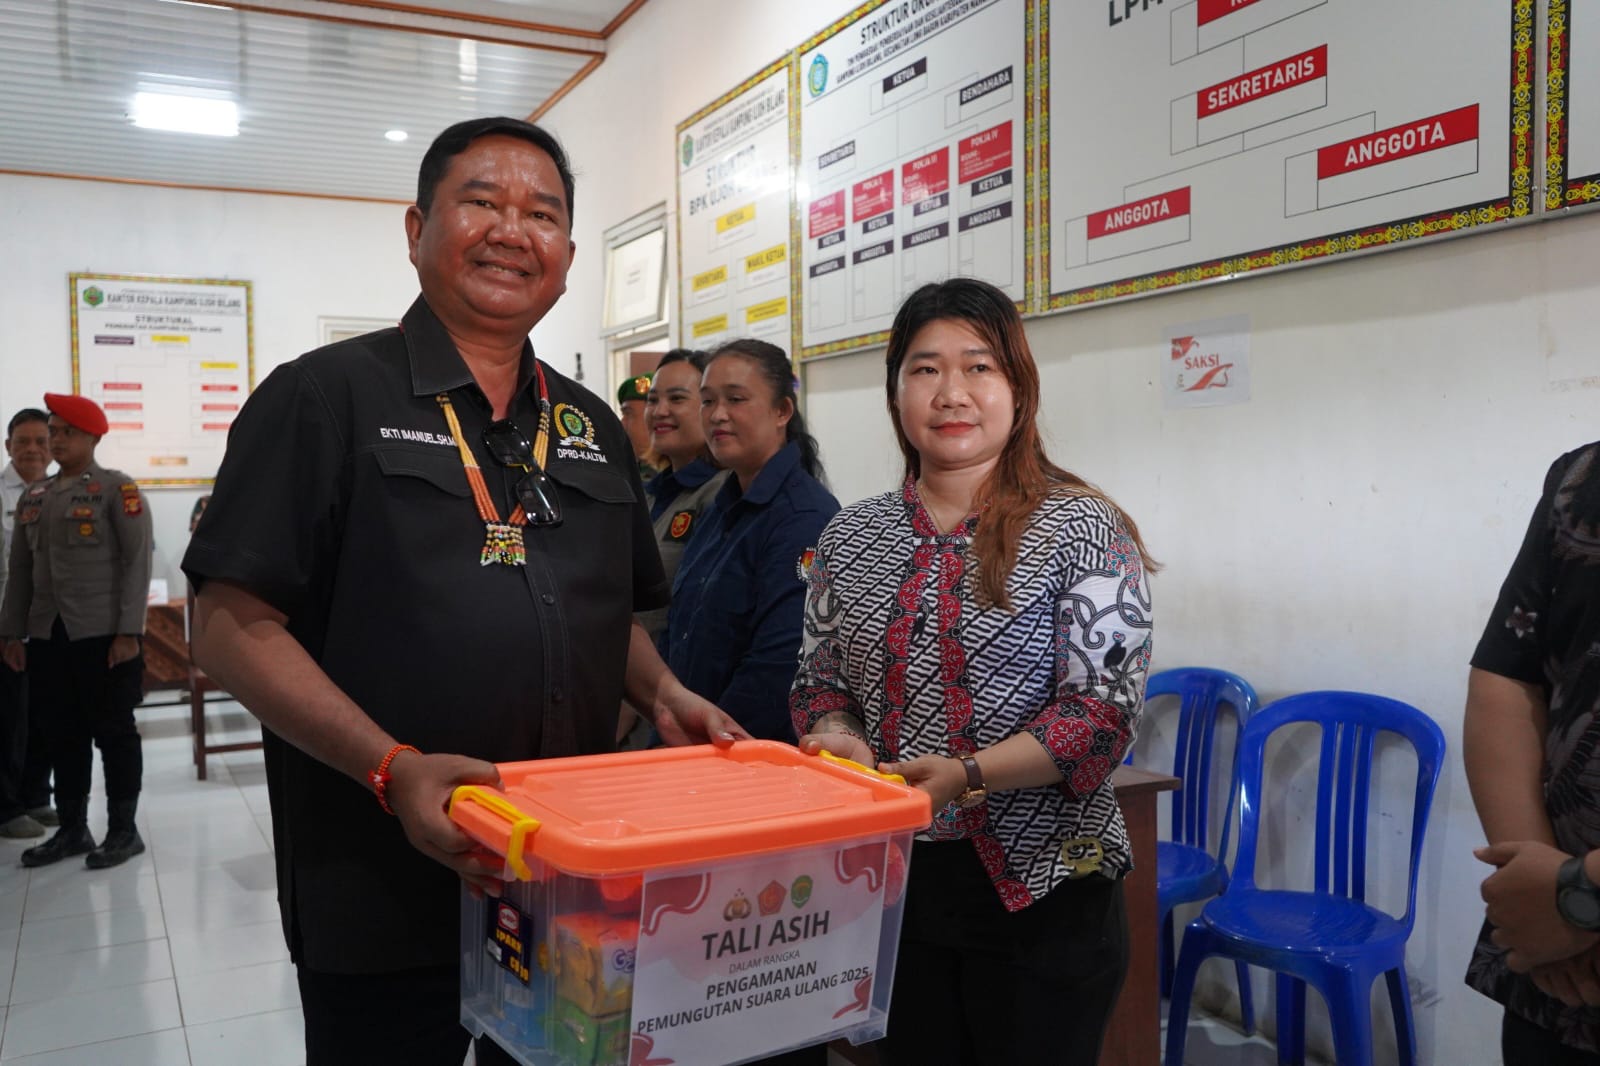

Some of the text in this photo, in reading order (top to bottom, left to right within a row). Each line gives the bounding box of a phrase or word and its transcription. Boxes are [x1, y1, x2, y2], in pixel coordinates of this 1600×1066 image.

[861, 2, 909, 45] STRUKTUR
[893, 66, 916, 86] KETUA
[961, 71, 1010, 102] BENDAHARA
[1208, 56, 1315, 110] SEKRETARIS
[1344, 121, 1446, 167] ANGGOTA
[979, 175, 1004, 192] KETUA
[968, 208, 1002, 227] ANGGOTA
[1104, 197, 1170, 231] ANGGOTA
[910, 227, 940, 244] ANGGOTA
[1185, 354, 1220, 370] SAKSI
[380, 428, 401, 439] EKTI
[557, 448, 608, 464] DPRD-KALTIM
[702, 910, 830, 960] TALI ASIH
[729, 950, 800, 975] DALAM RANGKA
[706, 961, 817, 1001] PENGAMANAN
[637, 966, 869, 1034] PEMUNGUTAN SUARA ULANG 2025
